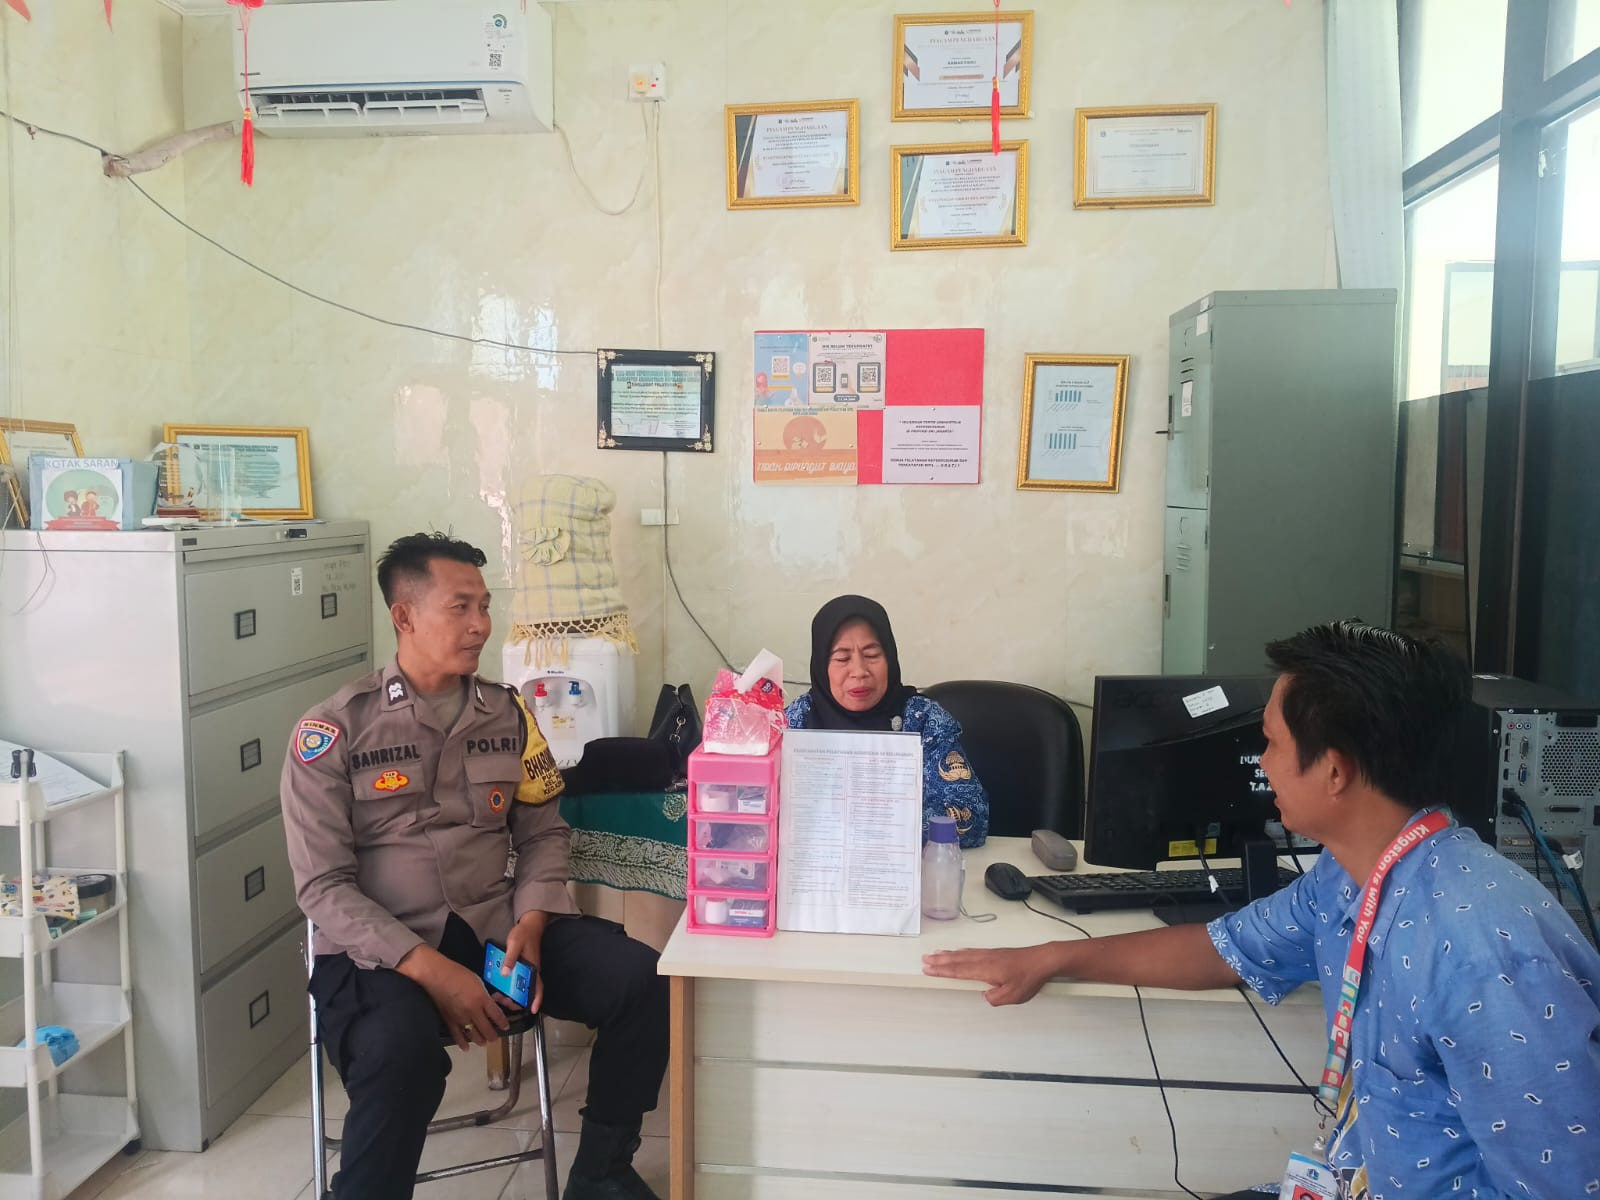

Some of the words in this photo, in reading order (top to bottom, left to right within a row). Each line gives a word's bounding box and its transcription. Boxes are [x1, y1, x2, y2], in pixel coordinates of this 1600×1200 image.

[45, 459, 80, 469] KOTAK
[83, 459, 117, 468] SARAN
[351, 744, 421, 770] SAHRIZAL
[466, 737, 517, 754] POLRI
[1378, 823, 1430, 872] Kingston
[1356, 919, 1370, 944] You
